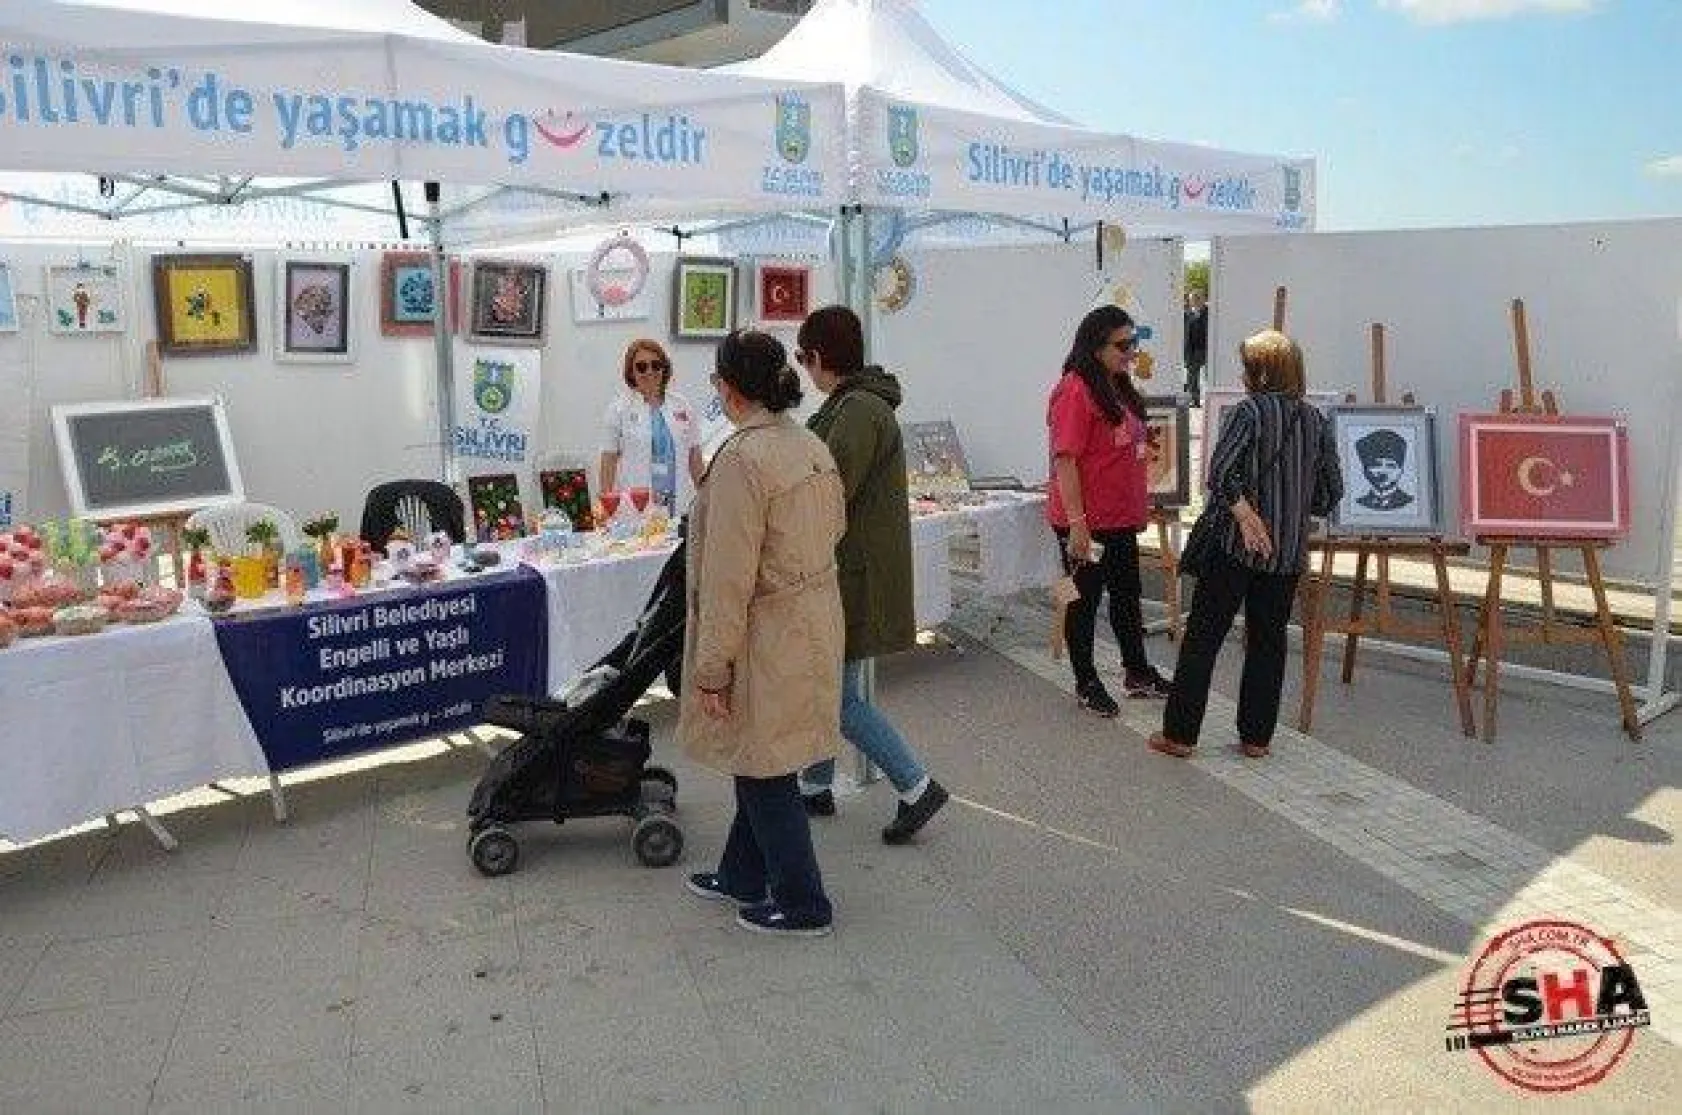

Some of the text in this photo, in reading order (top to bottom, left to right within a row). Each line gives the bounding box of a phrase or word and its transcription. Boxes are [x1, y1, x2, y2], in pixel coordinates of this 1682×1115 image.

[0, 56, 252, 131] ilivri'de
[273, 92, 488, 151] yaşamak
[969, 143, 1071, 188] Silivri'de
[1082, 163, 1165, 202] yaşamak
[307, 593, 477, 639] Silivri Belediyesi
[319, 624, 471, 669] Engelli ve Yaşlı
[280, 649, 504, 708] Koordinasyon Merkezi
